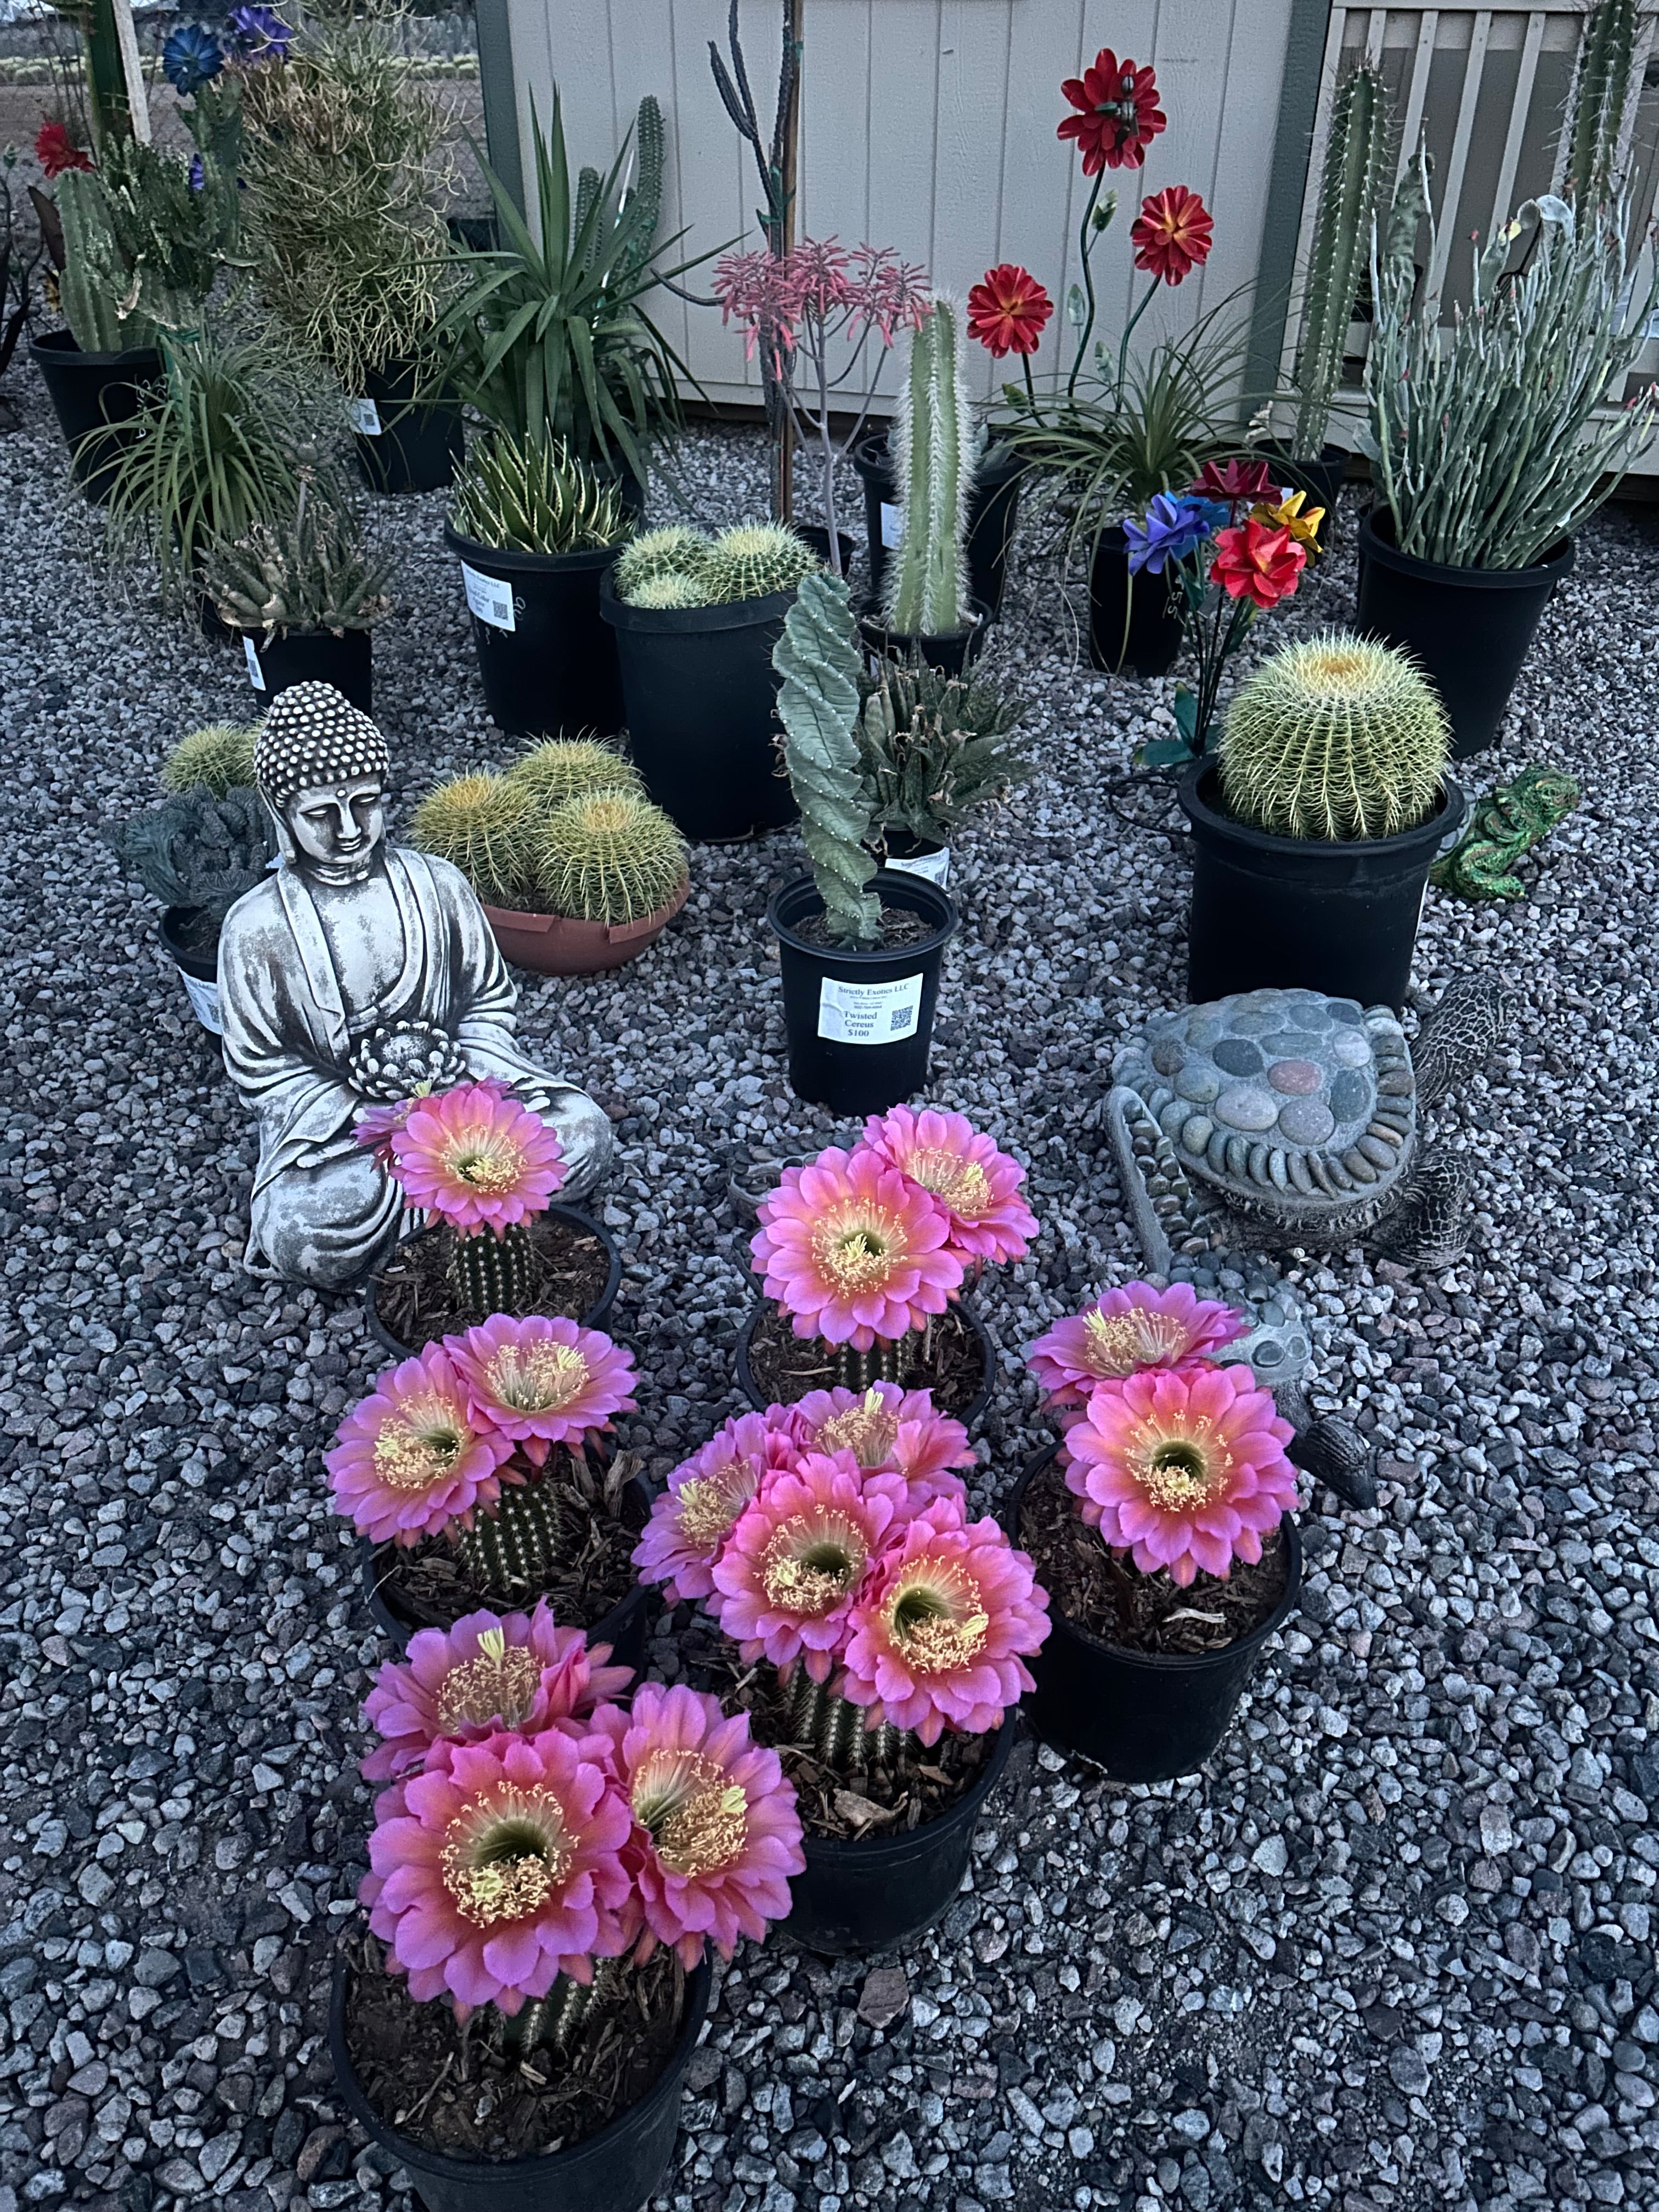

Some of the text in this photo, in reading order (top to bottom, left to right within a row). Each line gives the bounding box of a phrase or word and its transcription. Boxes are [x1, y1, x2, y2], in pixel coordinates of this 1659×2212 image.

[838, 986, 865, 996] Strictly
[894, 983, 910, 992] LLC
[843, 1010, 877, 1019] Twisted
[845, 1019, 874, 1028] Cereus
[848, 1029, 870, 1037] $100
